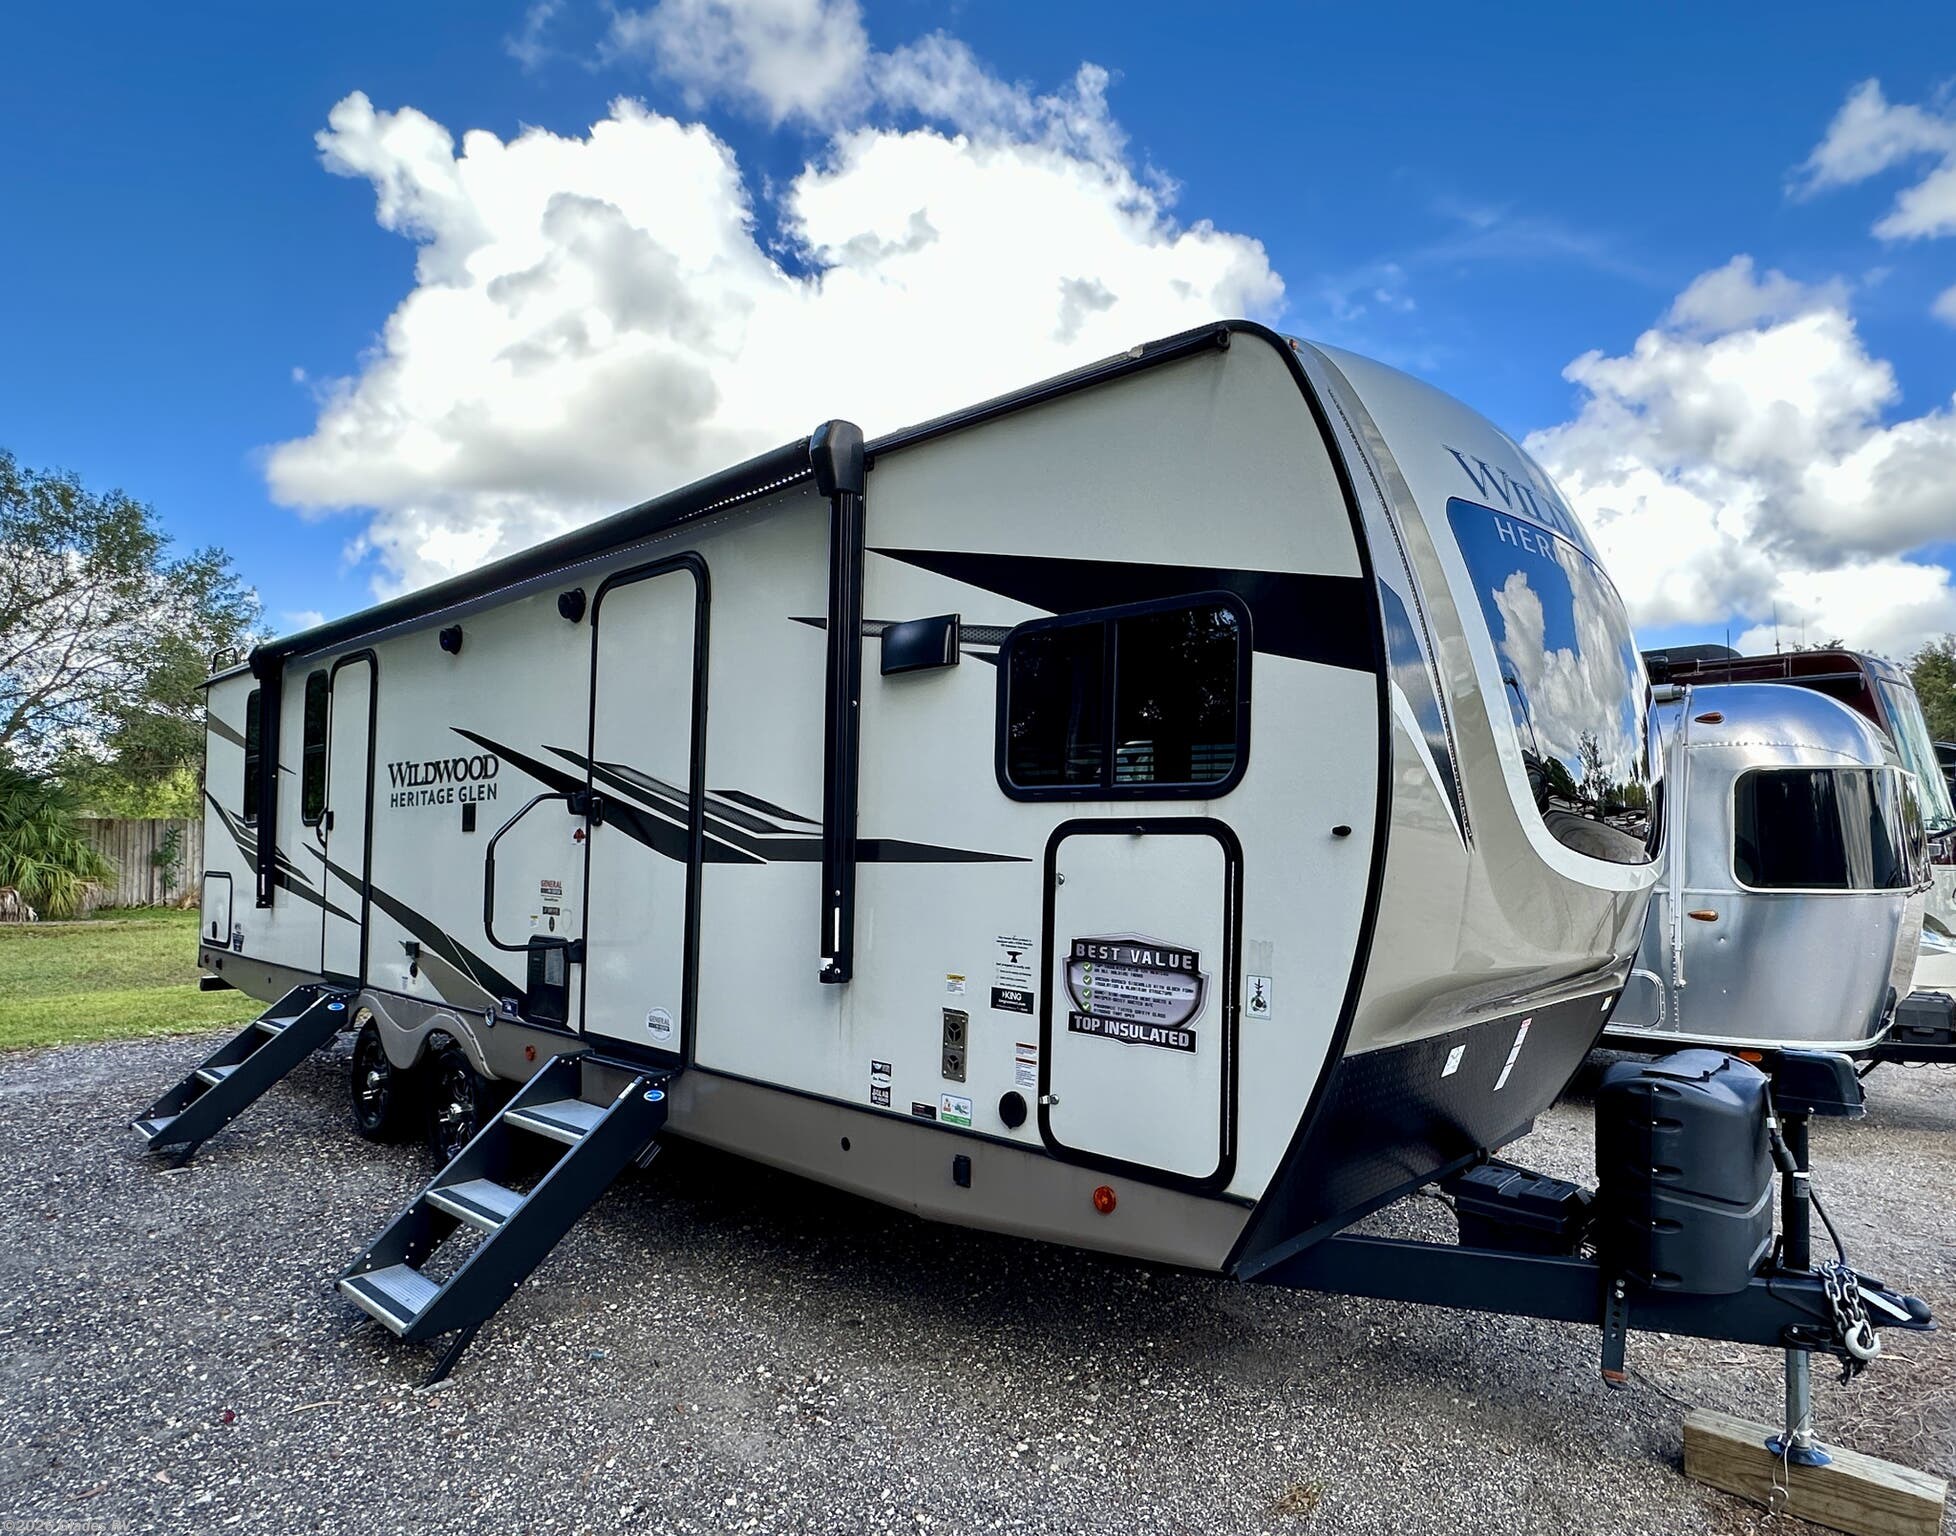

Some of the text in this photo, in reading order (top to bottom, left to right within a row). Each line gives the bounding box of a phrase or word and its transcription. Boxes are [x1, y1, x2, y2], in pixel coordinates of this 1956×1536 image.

[388, 754, 499, 788] WILDWOOD
[390, 783, 498, 808] HERITAGE GLEN
[1076, 943, 1120, 961] BEST
[1130, 949, 1193, 970] VALUE
[1074, 1015, 1190, 1047] TOP INSULATED
